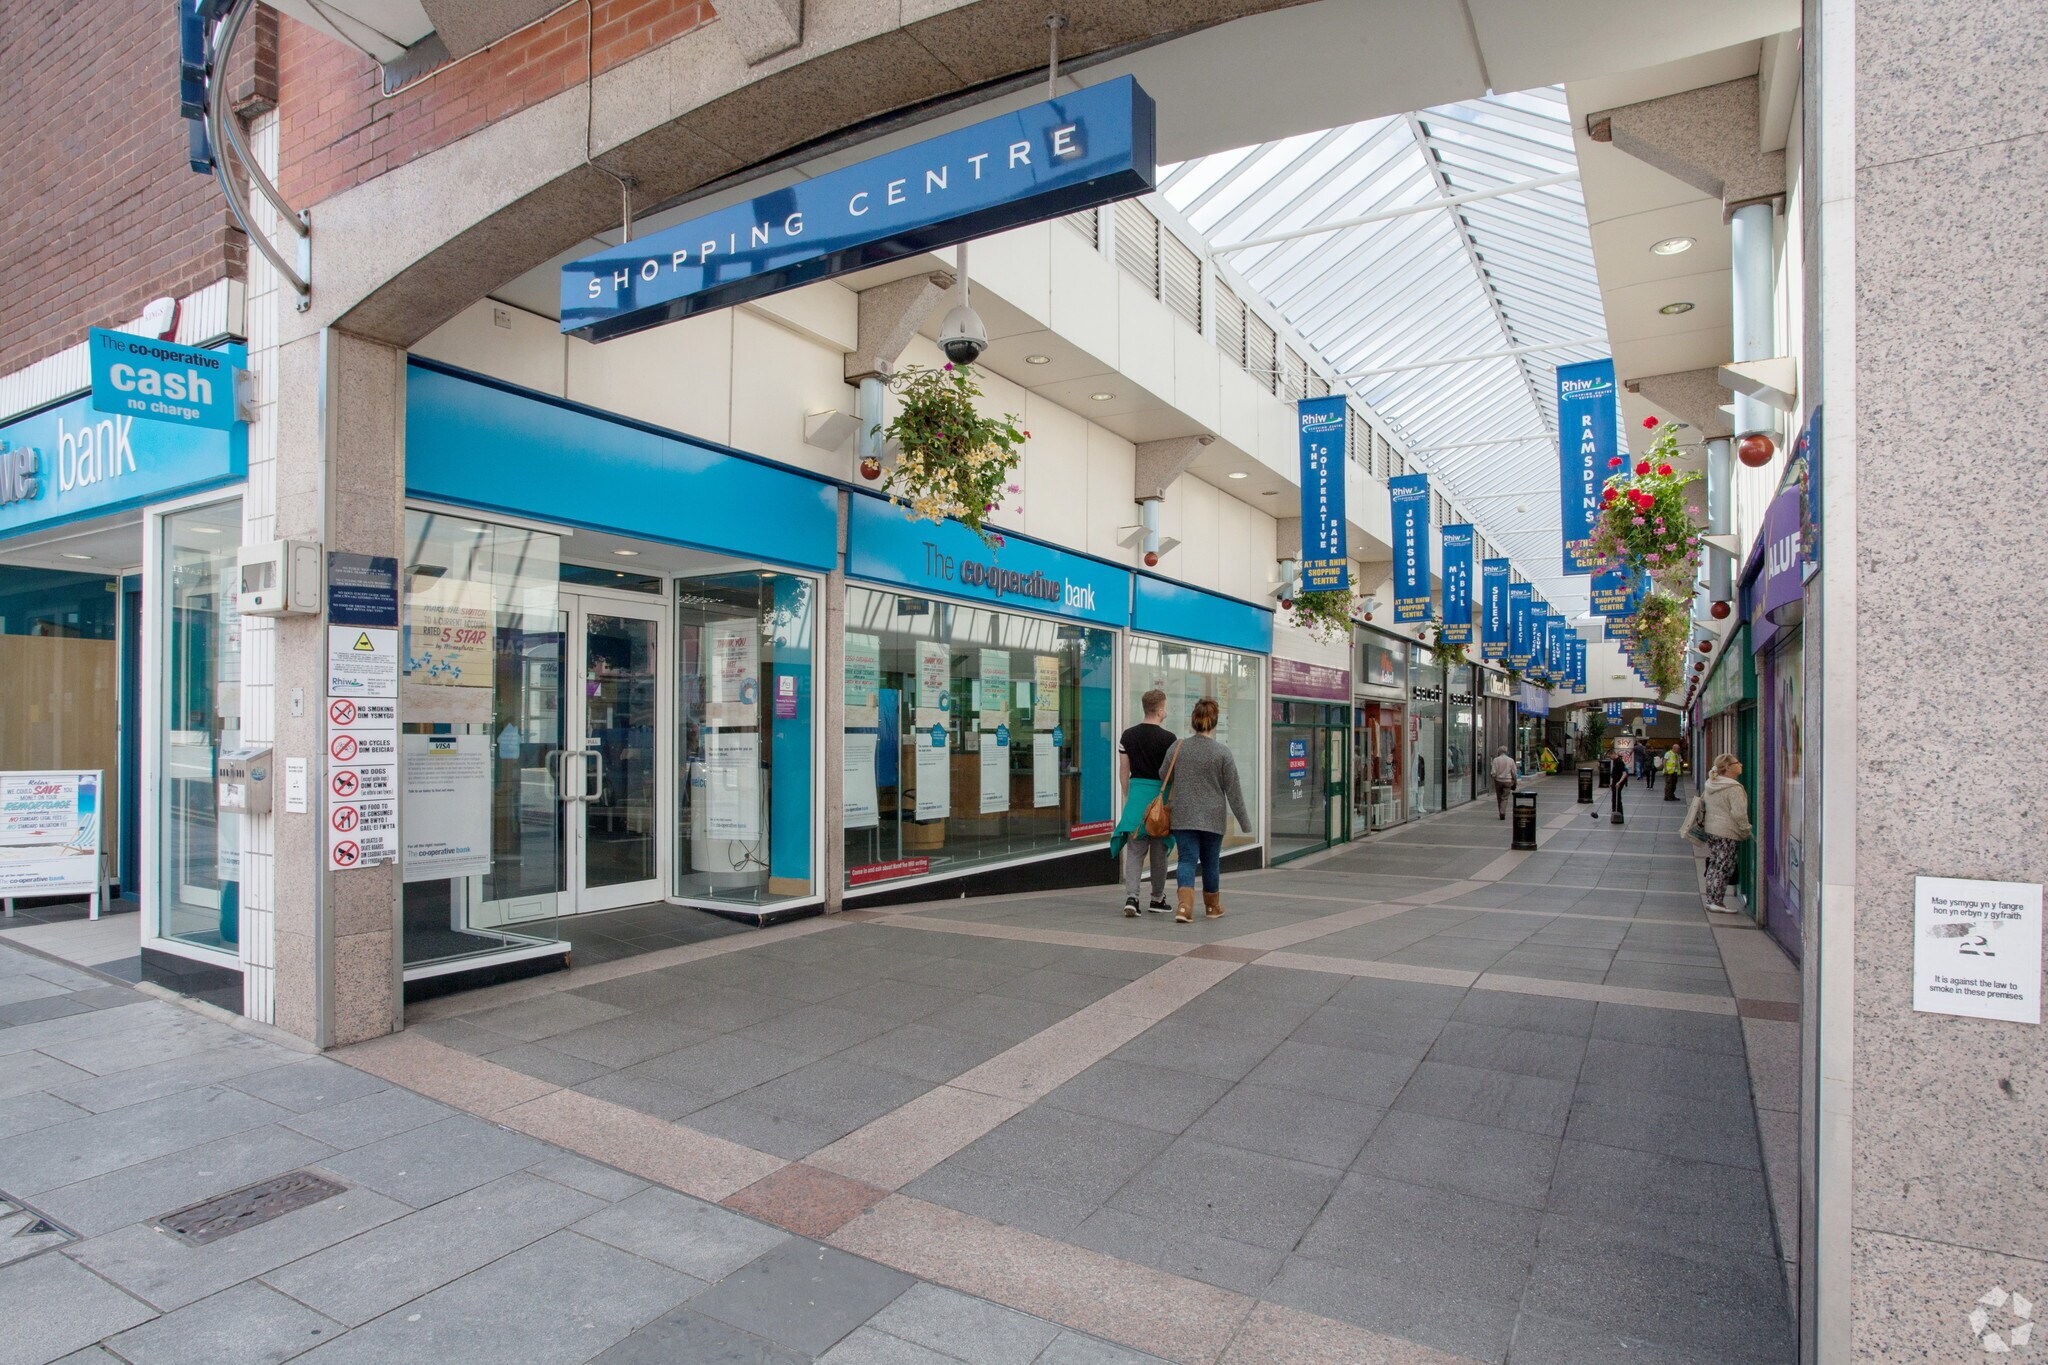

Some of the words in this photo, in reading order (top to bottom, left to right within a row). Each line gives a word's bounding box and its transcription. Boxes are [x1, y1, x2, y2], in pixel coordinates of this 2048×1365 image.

[588, 212, 804, 300] SHOPPING
[849, 125, 1077, 216] CENTRE
[100, 334, 125, 351] The
[129, 343, 219, 369] co-operative
[110, 363, 212, 405] cash
[1561, 379, 1592, 392] Rhiw
[128, 399, 146, 410] no
[151, 401, 200, 420] charge
[1302, 413, 1327, 425] Rhiw
[58, 414, 136, 491] bank
[1581, 415, 1596, 522] RAMSDENS
[1393, 487, 1413, 496] Rhiw
[1405, 509, 1416, 586] JOHNSONS
[1329, 558, 1346, 566] RHIW
[922, 541, 955, 582] The
[960, 558, 1062, 603] co-operative
[1064, 578, 1096, 612] bank
[1308, 568, 1340, 577] SHOPPING
[1313, 577, 1338, 585] CENTRE
[1449, 566, 1457, 601] MISS
[1595, 596, 1626, 604] SHOPPING
[1600, 603, 1624, 611] CENTRE
[424, 605, 444, 613] MAKE
[461, 608, 487, 616] SWITCH
[424, 627, 440, 636] RATED
[441, 628, 452, 643] 5
[454, 629, 487, 644] STAR
[1416, 686, 1443, 702] SELECT
[1452, 693, 1473, 707] SELECT
[33, 785, 62, 795] SAVE
[4, 800, 72, 811] REMORTGAGE
[418, 848, 455, 857] co-operative
[456, 846, 470, 854] bank
[1932, 897, 1948, 905] Mae
[1949, 899, 1979, 909] ysmygu
[1980, 901, 1990, 909] yn
[1999, 901, 2024, 912] fangre
[1933, 906, 1948, 915] hon
[1949, 908, 1959, 916] yn
[1960, 908, 1982, 918] erbyn
[1984, 911, 1989, 919] y
[1991, 909, 2022, 920] gyfraith
[1935, 975, 1941, 983] It
[1941, 975, 1948, 983] is
[1950, 976, 1978, 987] against
[1979, 979, 1992, 987] the
[1994, 980, 2007, 989] law
[2009, 982, 2018, 990] to
[1930, 985, 1954, 994] smoke
[1956, 986, 1963, 994] in
[1964, 987, 1986, 997] these
[1987, 990, 2024, 1001] premises
